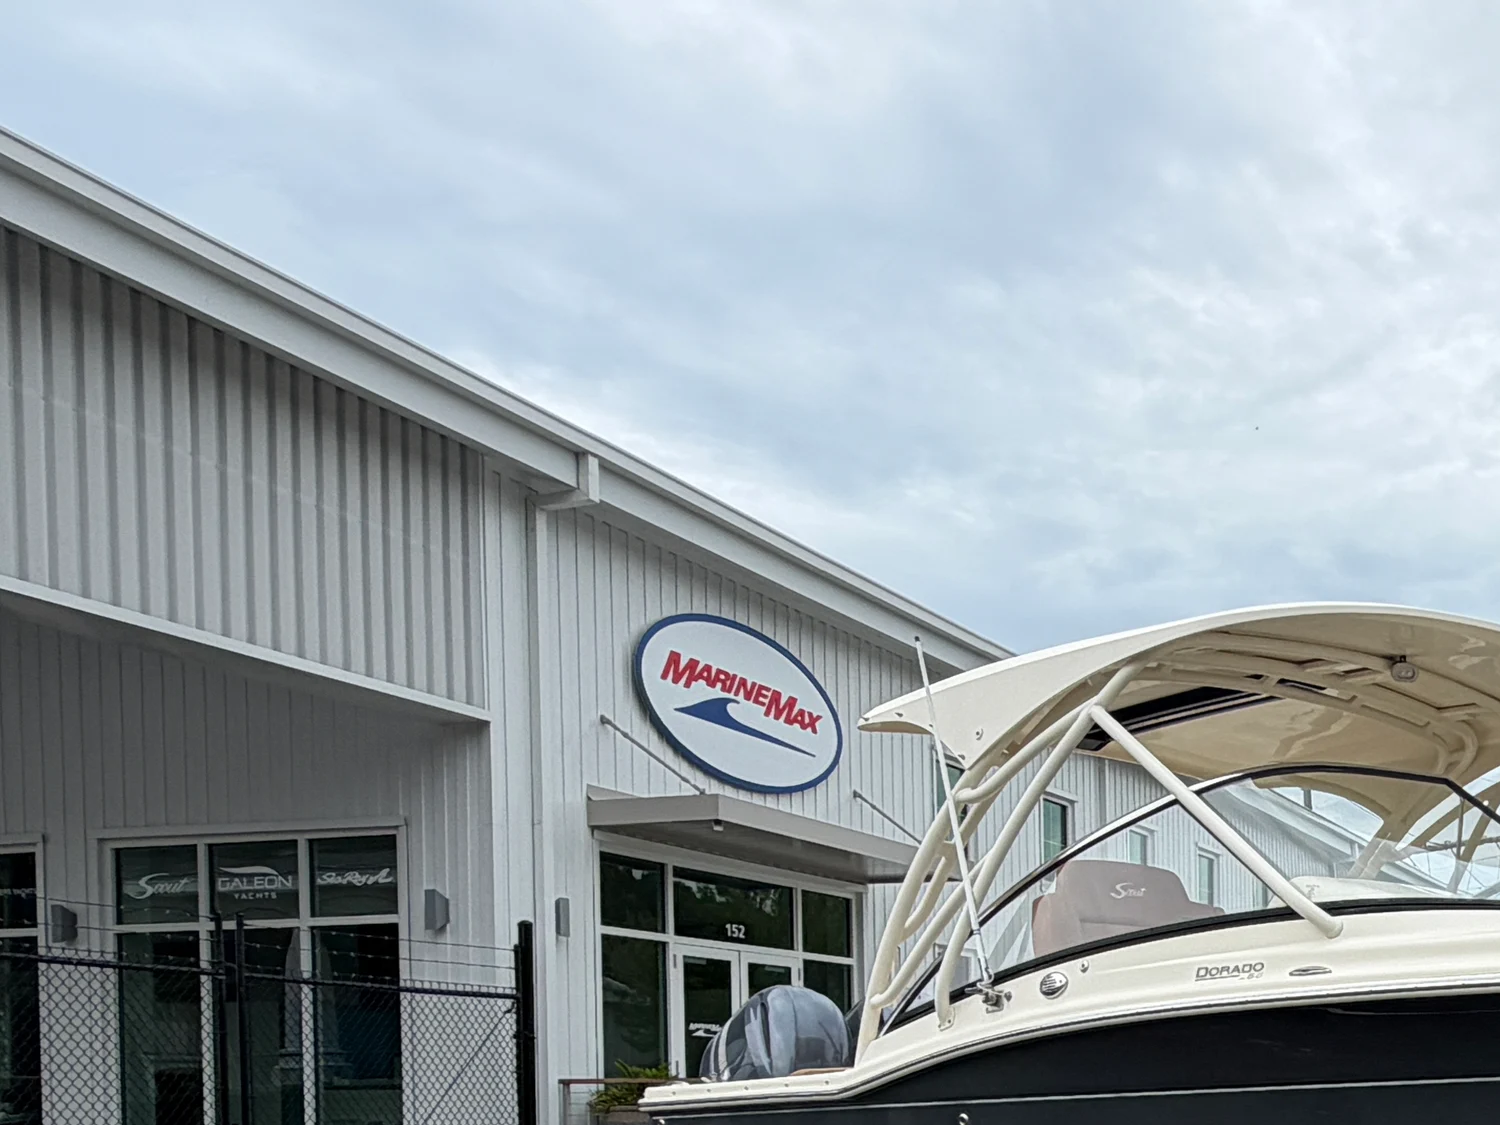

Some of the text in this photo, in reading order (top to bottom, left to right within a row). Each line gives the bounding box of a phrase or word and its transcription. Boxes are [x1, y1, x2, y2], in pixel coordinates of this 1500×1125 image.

[124, 873, 190, 899] Scout
[218, 876, 293, 890] GALEON
[234, 892, 277, 900] YACHTS
[725, 923, 746, 939] 152
[1195, 962, 1264, 978] DORADO
